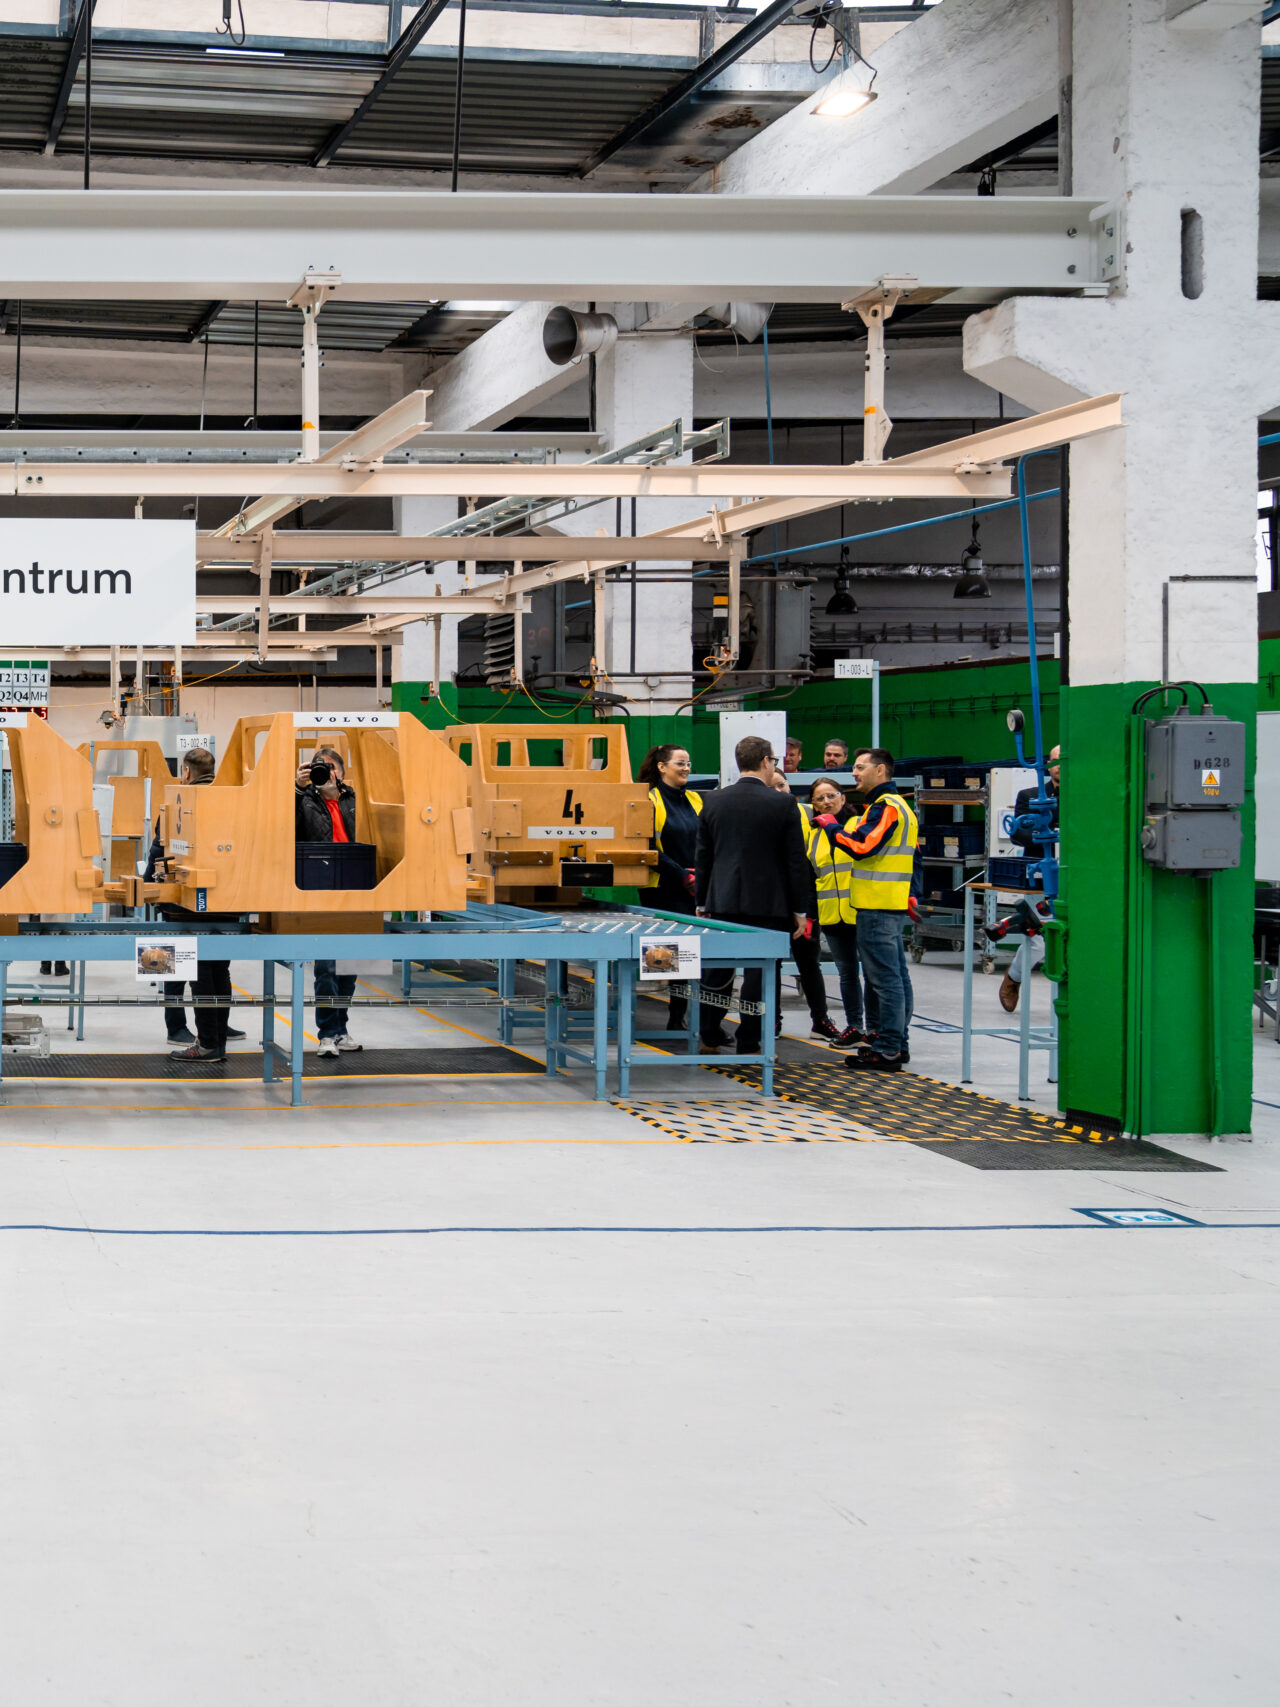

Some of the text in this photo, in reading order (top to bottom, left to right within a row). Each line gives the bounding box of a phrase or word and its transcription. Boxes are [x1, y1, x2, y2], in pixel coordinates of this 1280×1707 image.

[14, 673, 28, 683] T3
[31, 673, 46, 683] T4
[13, 690, 29, 702] Q4
[30, 691, 48, 700] MH
[1204, 757, 1231, 768] 628
[562, 789, 584, 824] 4
[198, 892, 206, 911] FSP
